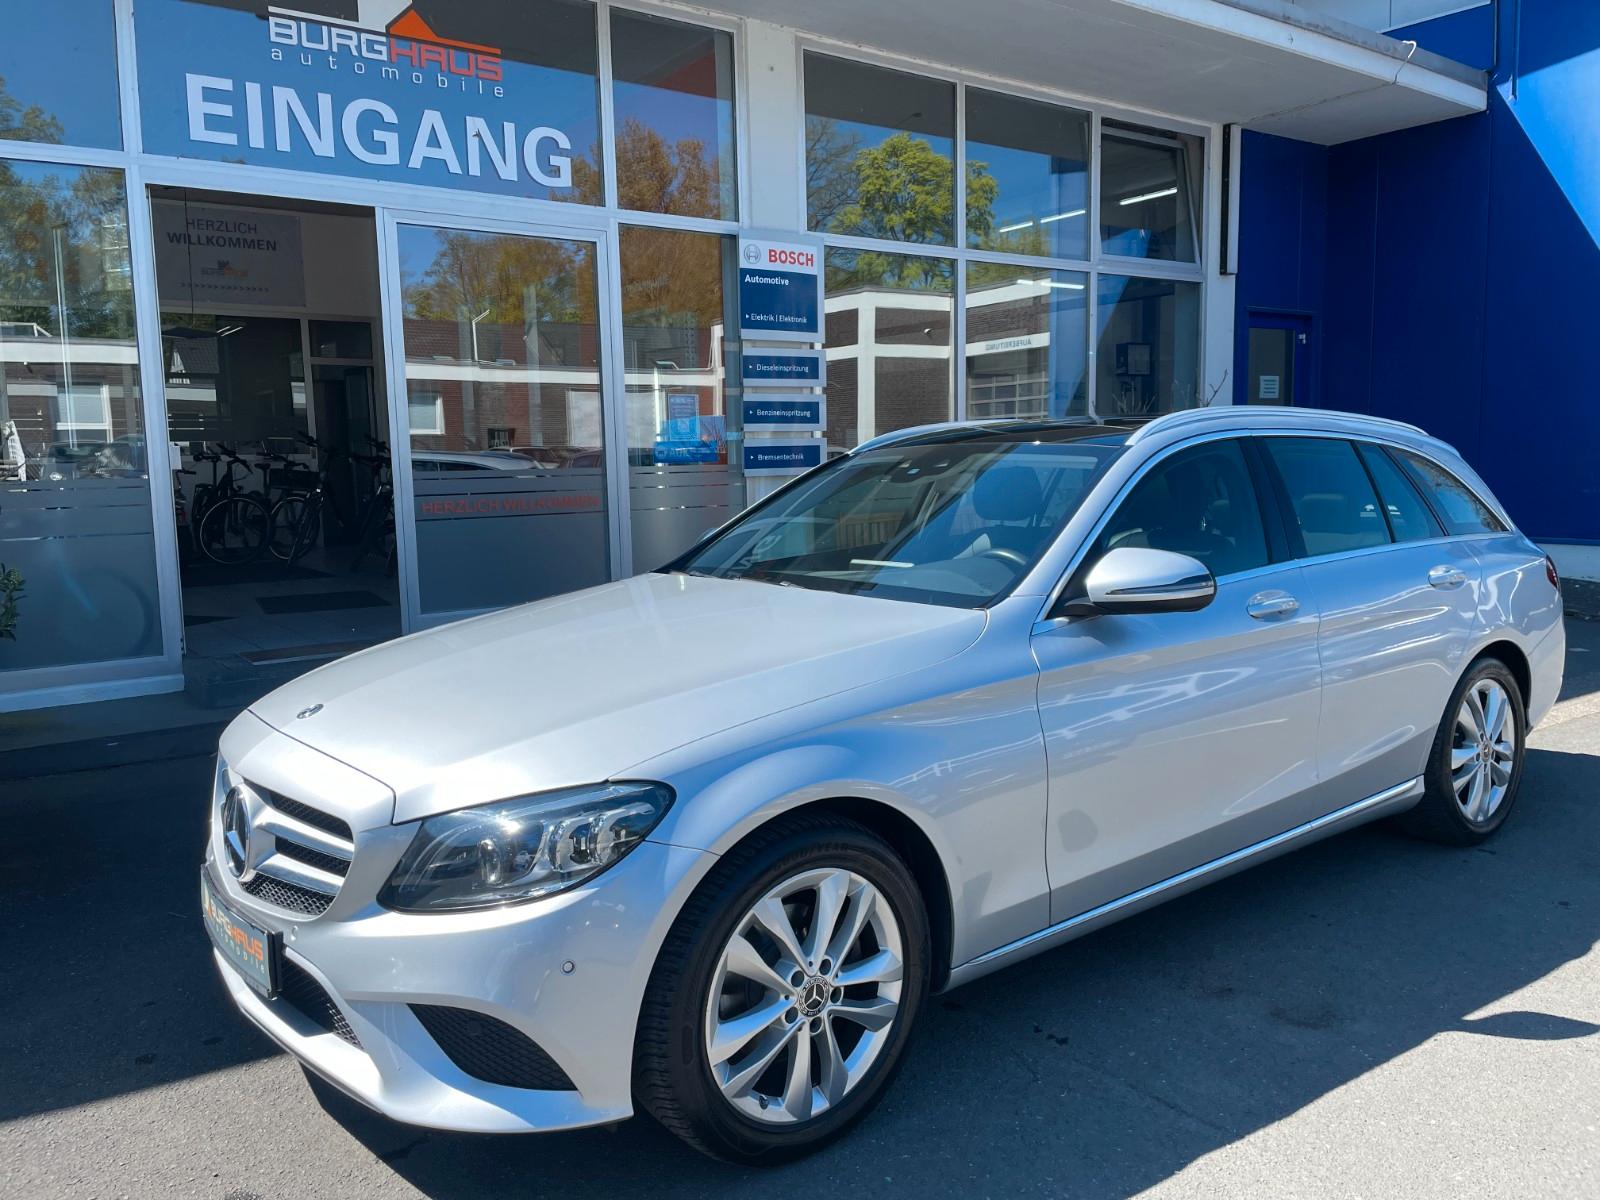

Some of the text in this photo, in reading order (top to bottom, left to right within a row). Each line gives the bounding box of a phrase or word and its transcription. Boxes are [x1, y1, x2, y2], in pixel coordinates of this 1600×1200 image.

[268, 15, 503, 82] BURGHAUS
[271, 47, 505, 98] automobile
[185, 72, 573, 188] EINGANG
[186, 217, 258, 234] HERZLICH
[167, 231, 277, 251] WILLKOMMEN
[768, 248, 814, 267] BOSCH
[744, 274, 790, 286] Automotive
[750, 313, 774, 322] Elektrik
[779, 314, 808, 324] Elektronik
[756, 363, 809, 373] Dieseleinspritzung
[756, 409, 811, 418] Benzineinspritzung
[757, 453, 804, 461] Bremsentechnik
[421, 500, 498, 515] HERZLICH
